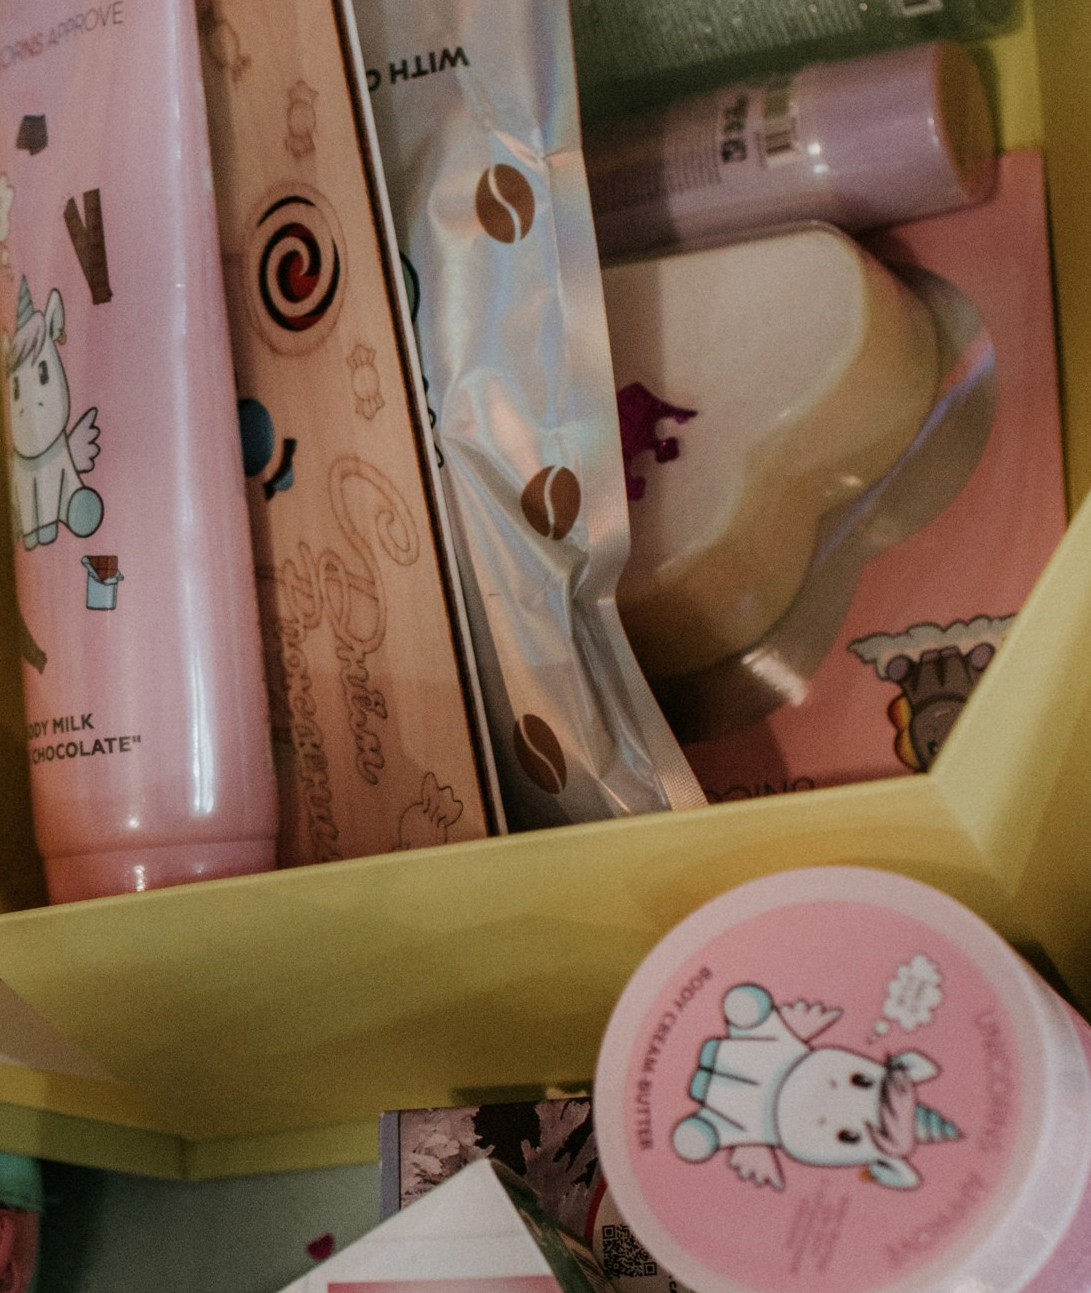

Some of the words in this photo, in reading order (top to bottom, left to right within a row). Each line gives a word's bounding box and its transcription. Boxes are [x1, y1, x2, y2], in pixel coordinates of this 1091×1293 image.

[47, 1, 124, 45] APPROVE
[389, 46, 469, 85] WITH
[52, 713, 95, 735] MILK
[674, 967, 712, 1009] BODY
[642, 1011, 676, 1073] CREAM
[637, 1079, 653, 1150] BUTTER
